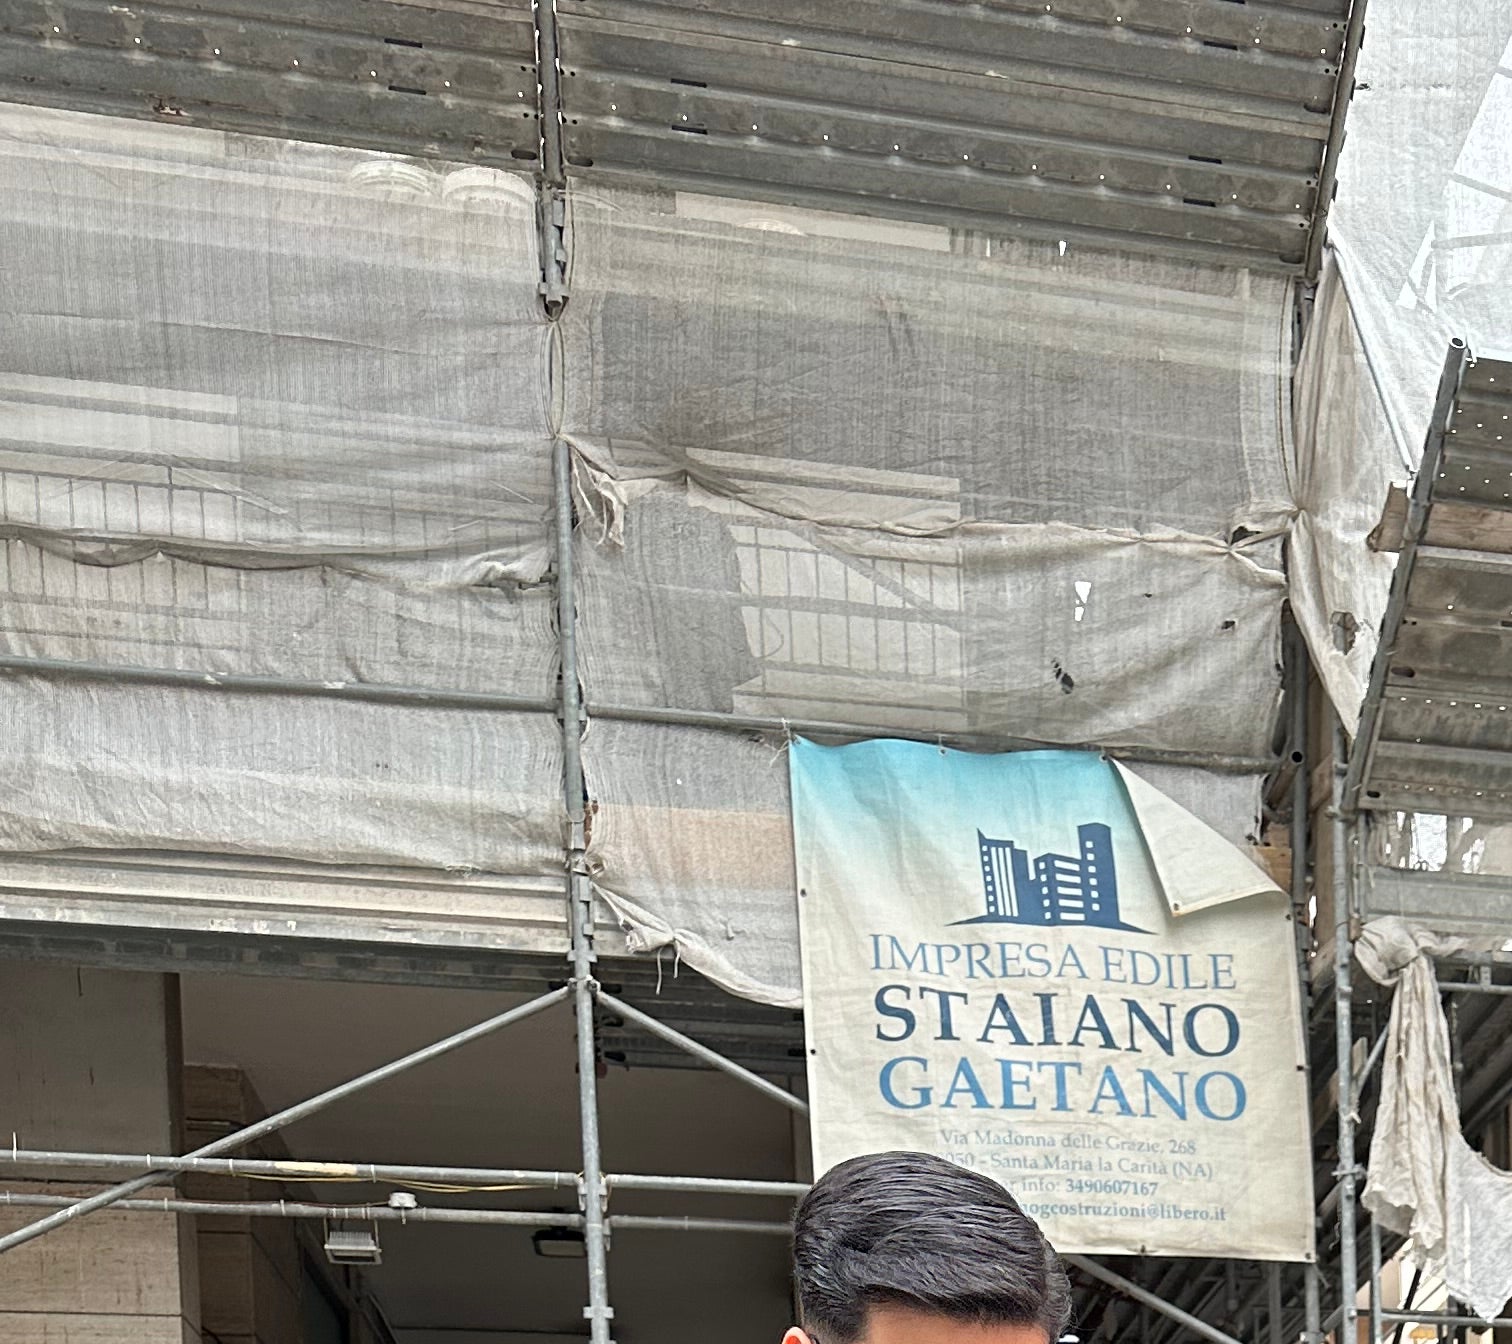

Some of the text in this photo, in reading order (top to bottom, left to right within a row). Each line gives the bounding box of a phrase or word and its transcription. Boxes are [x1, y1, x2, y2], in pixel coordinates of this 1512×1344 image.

[869, 933, 1236, 990] IMPRESA EDILE
[875, 983, 1241, 1058] STAIANO
[878, 1055, 1247, 1121] GAETANO
[941, 1129, 968, 1146] Via
[974, 1130, 1057, 1148] Madonna
[1061, 1132, 1101, 1149] delle
[1168, 1139, 1197, 1155] 268
[990, 1154, 1040, 1170] Santa
[1043, 1155, 1094, 1172] Maria
[1099, 1156, 1113, 1172] la
[1172, 1162, 1213, 1180] (NA)
[1065, 1178, 1158, 1196] 3490607167
